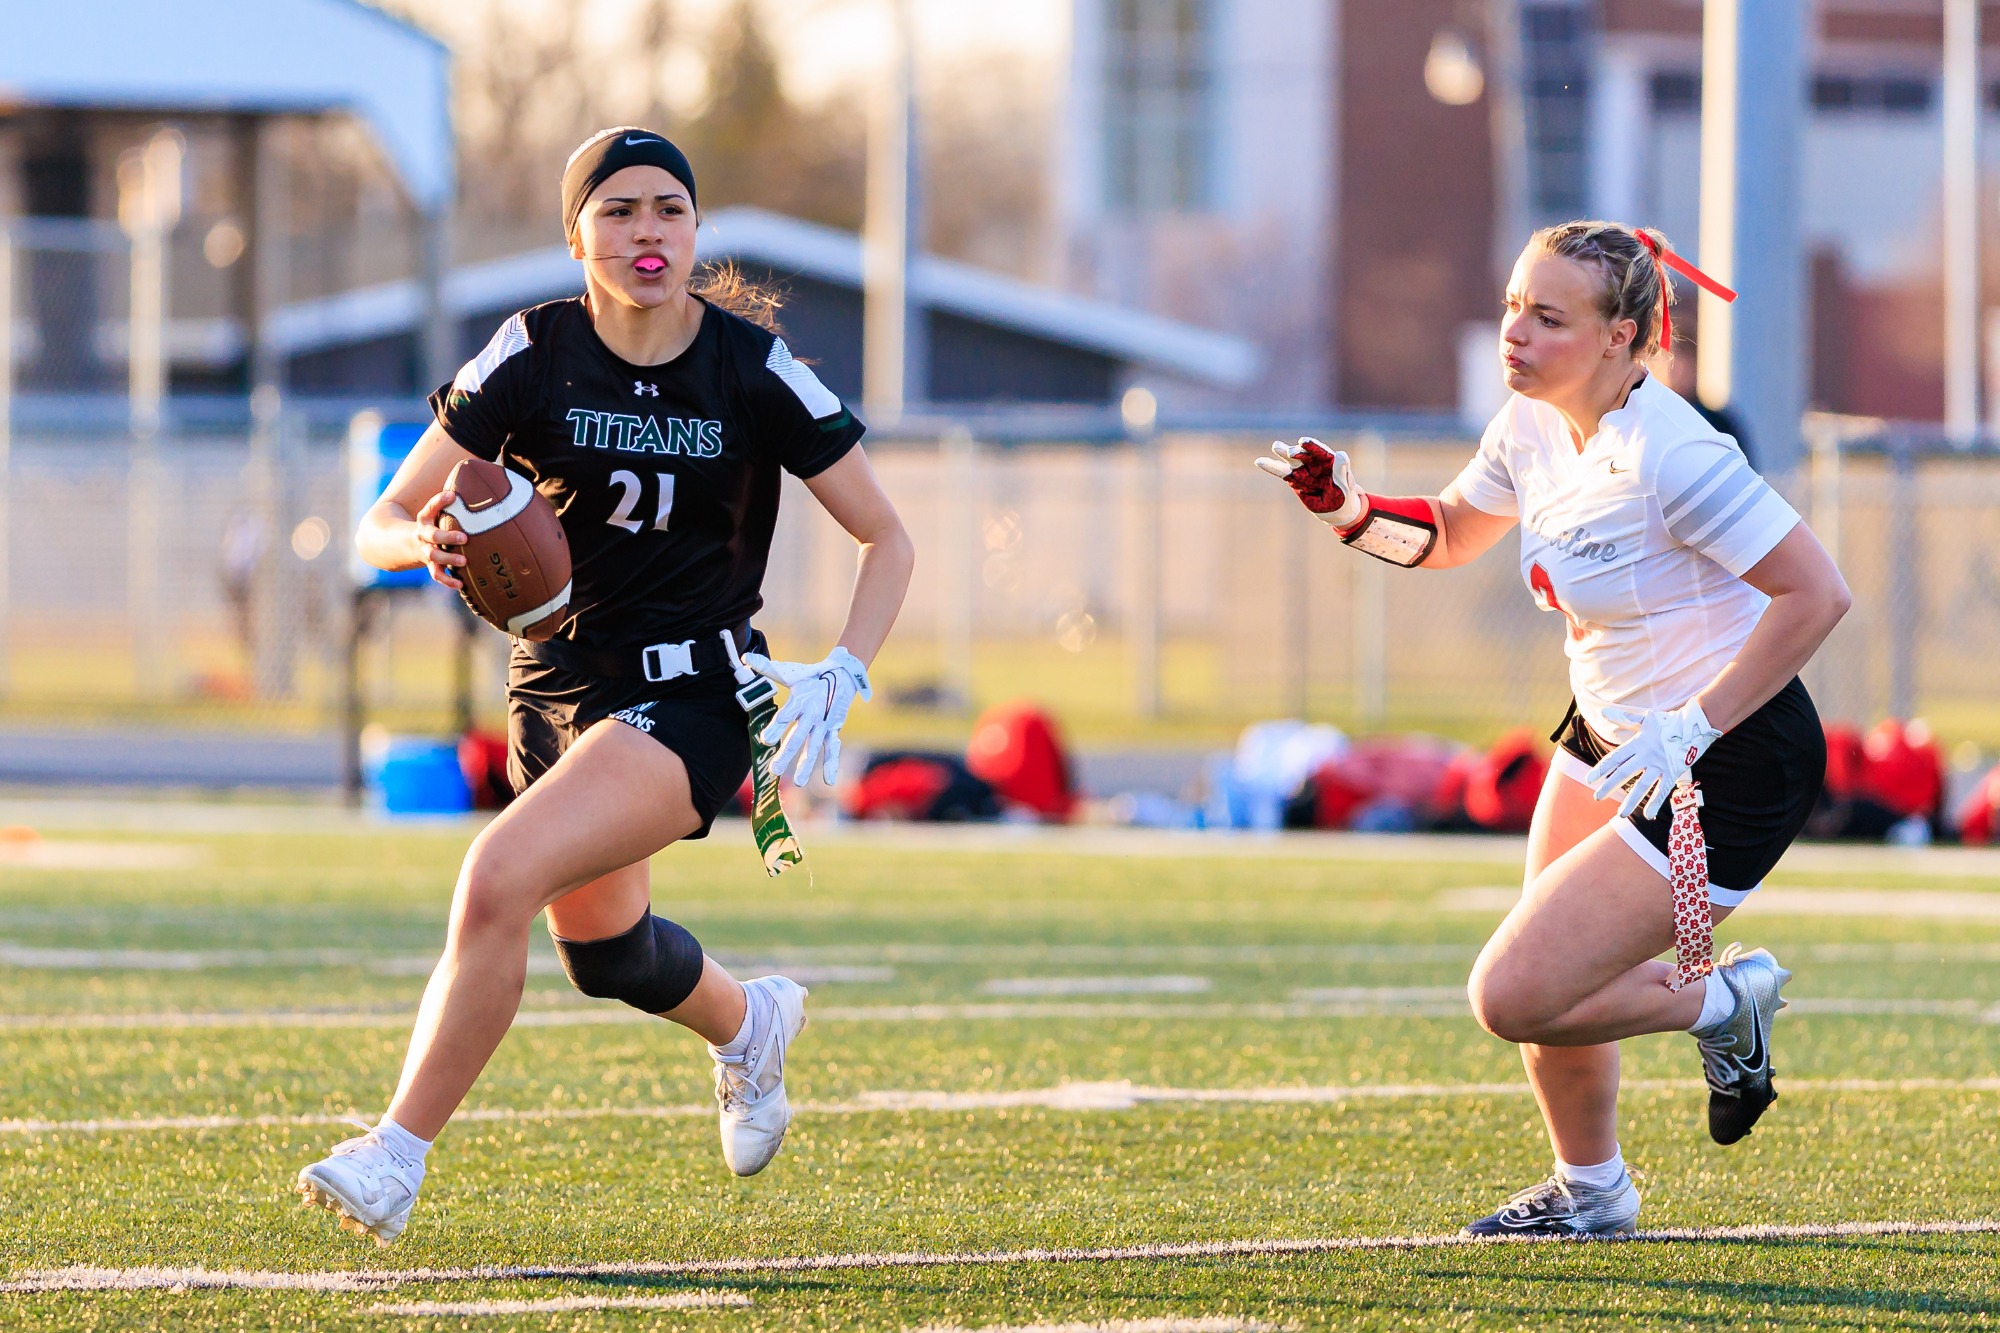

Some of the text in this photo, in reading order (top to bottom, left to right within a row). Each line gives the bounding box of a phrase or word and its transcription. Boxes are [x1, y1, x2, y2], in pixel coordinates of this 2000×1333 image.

[566, 408, 722, 457] TITANS
[606, 469, 675, 534] 21
[489, 552, 518, 600] FLAG
[853, 673, 868, 689] NIKE
